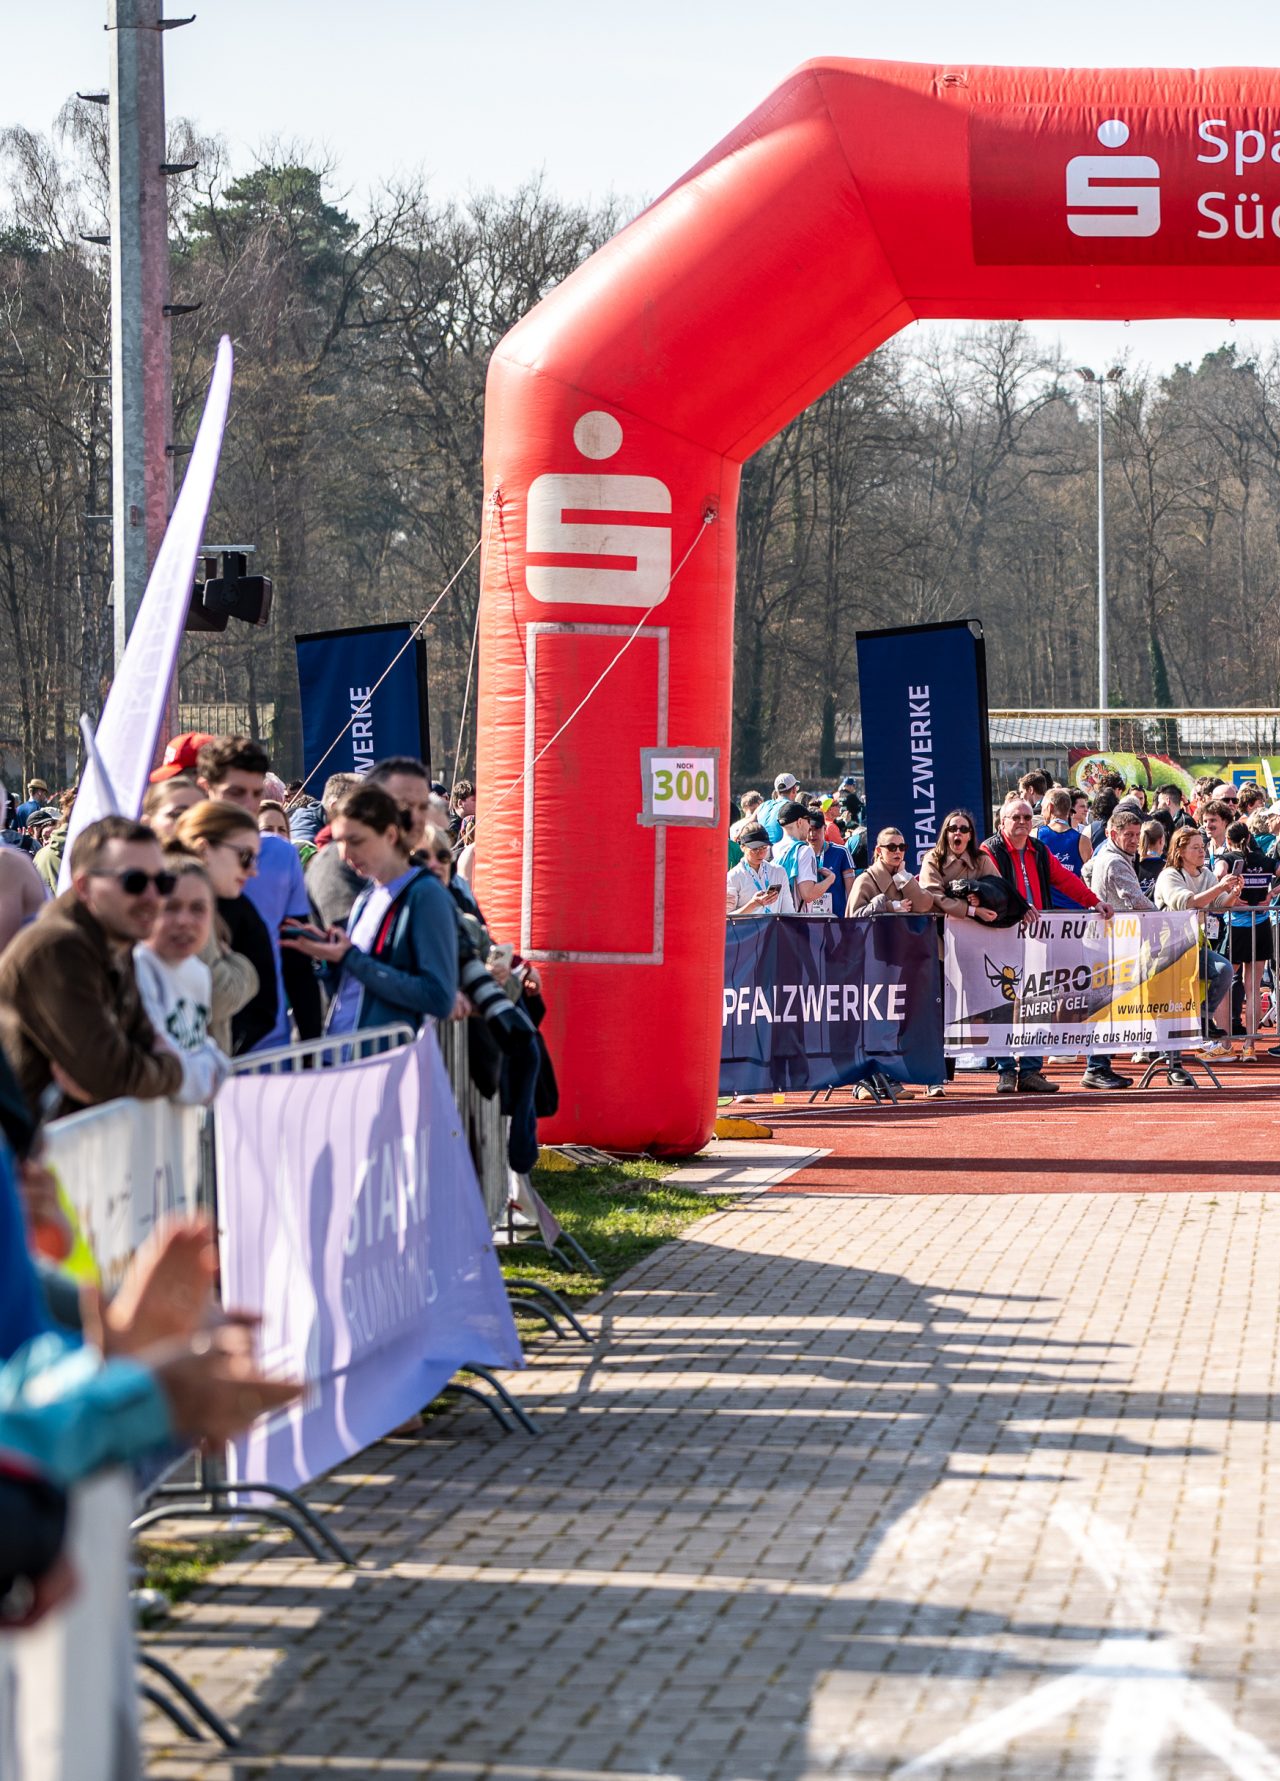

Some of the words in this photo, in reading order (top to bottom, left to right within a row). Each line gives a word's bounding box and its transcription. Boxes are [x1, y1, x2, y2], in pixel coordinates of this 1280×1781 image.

[676, 762, 694, 770] NOCH
[653, 769, 710, 802] 300
[1016, 920, 1055, 939] RUN.
[1060, 919, 1100, 939] RUN.
[1022, 958, 1136, 998] AEROBEE
[722, 984, 907, 1027] PFALZWERKE
[1019, 999, 1062, 1018] ENERGY
[1065, 996, 1089, 1011] GEL
[1117, 999, 1196, 1015] www.aerobee.de
[1005, 1032, 1060, 1046] Natürliche
[1061, 1031, 1101, 1046] Energie
[1102, 1033, 1121, 1043] aus
[1123, 1029, 1153, 1044] Honig
